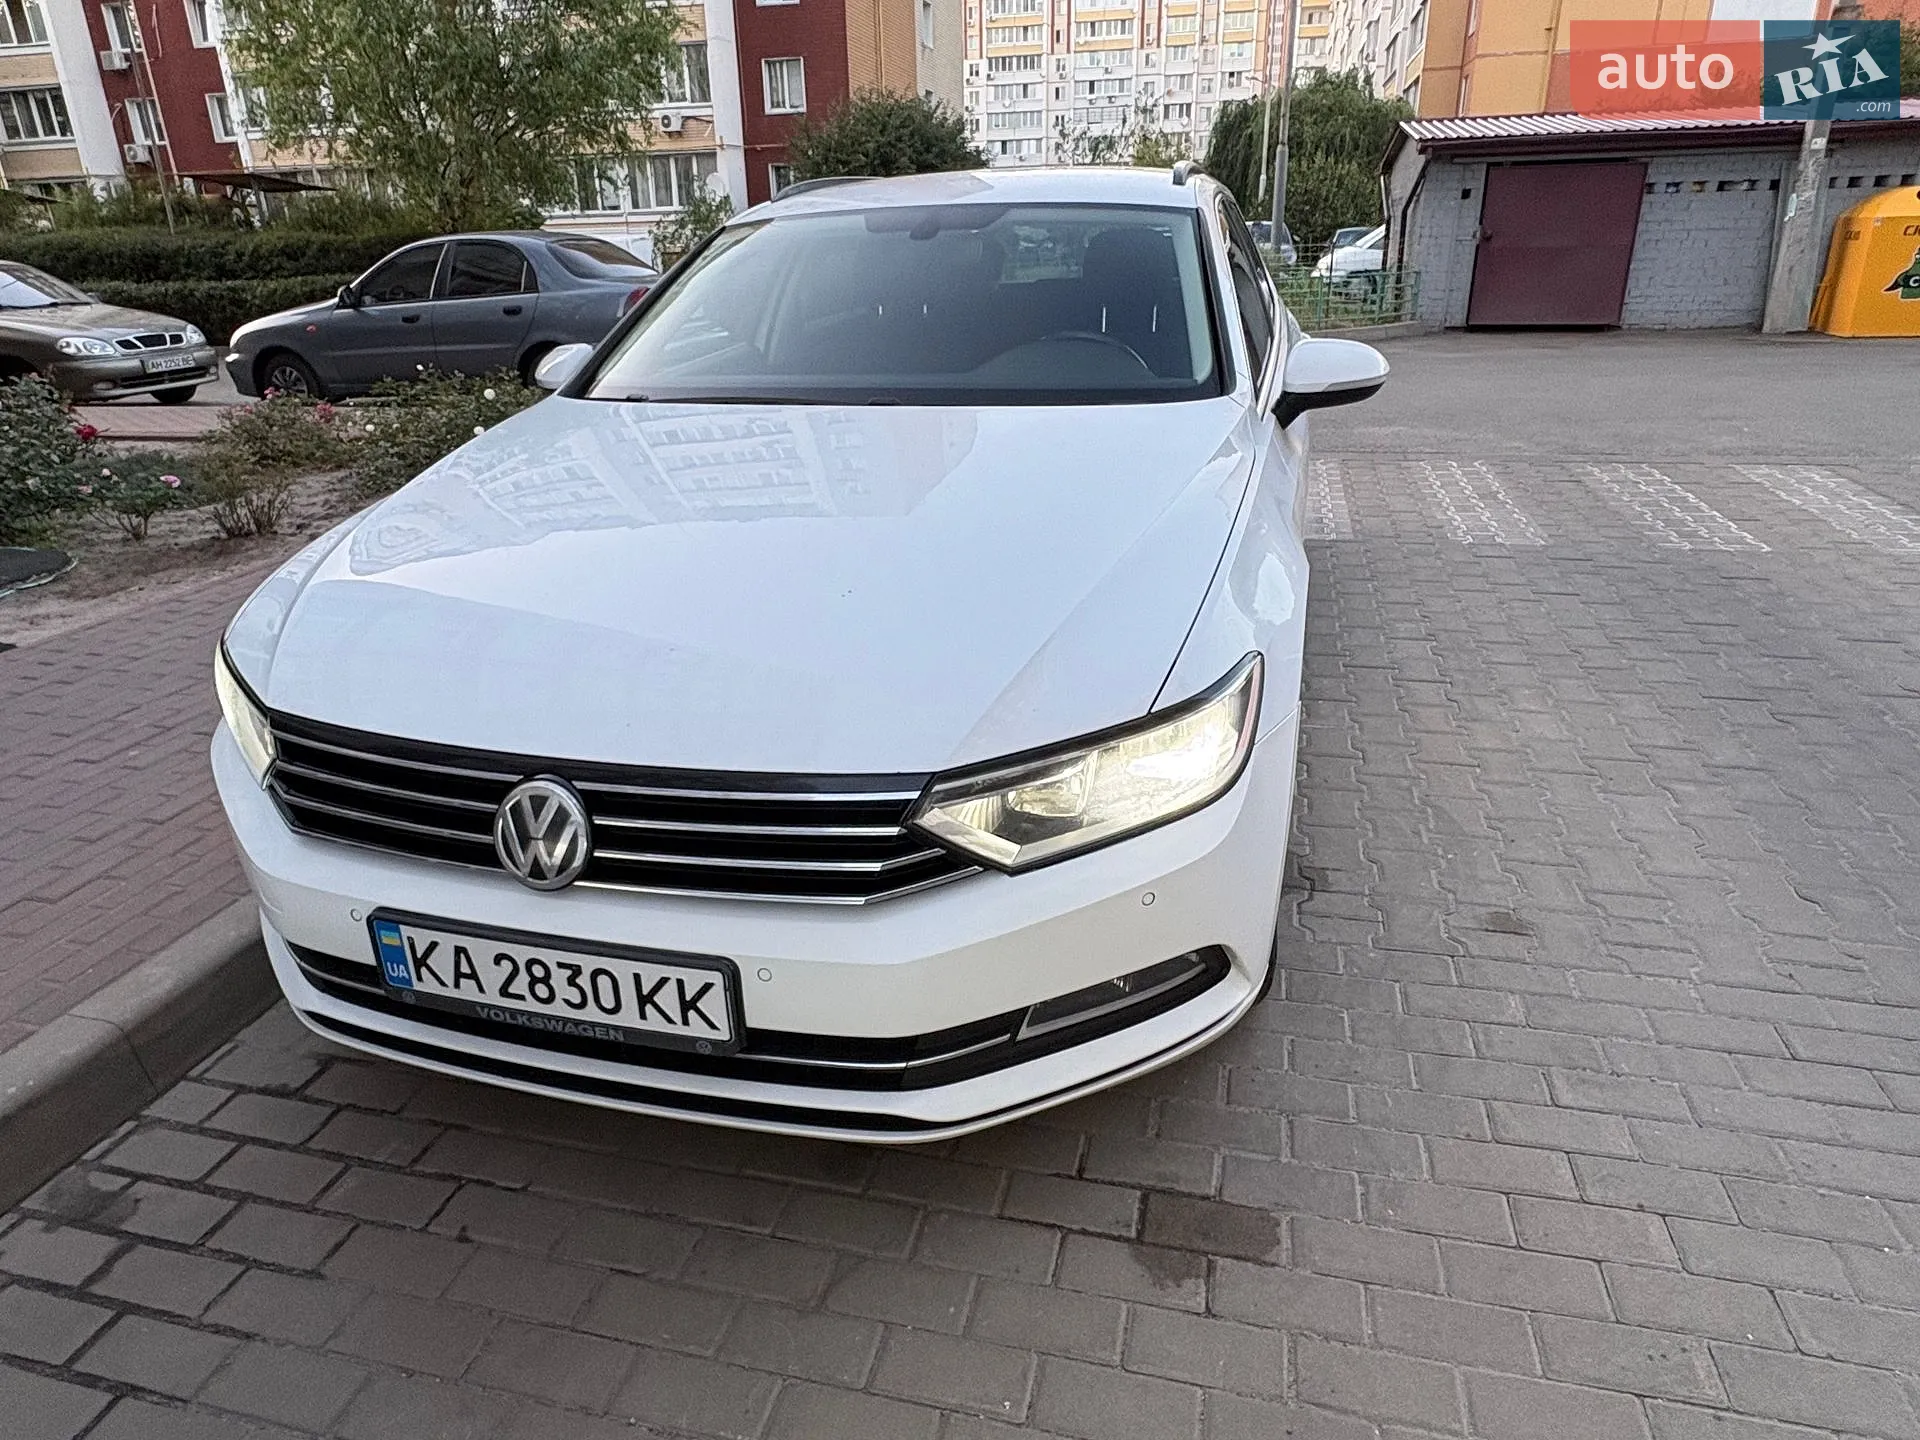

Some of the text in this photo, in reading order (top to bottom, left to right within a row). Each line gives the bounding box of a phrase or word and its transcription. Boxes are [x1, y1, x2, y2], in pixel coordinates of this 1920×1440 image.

[386, 961, 410, 979] UA
[406, 936, 721, 1032] KA 2830 KK
[474, 1005, 625, 1042] VOLKSWAGEN
